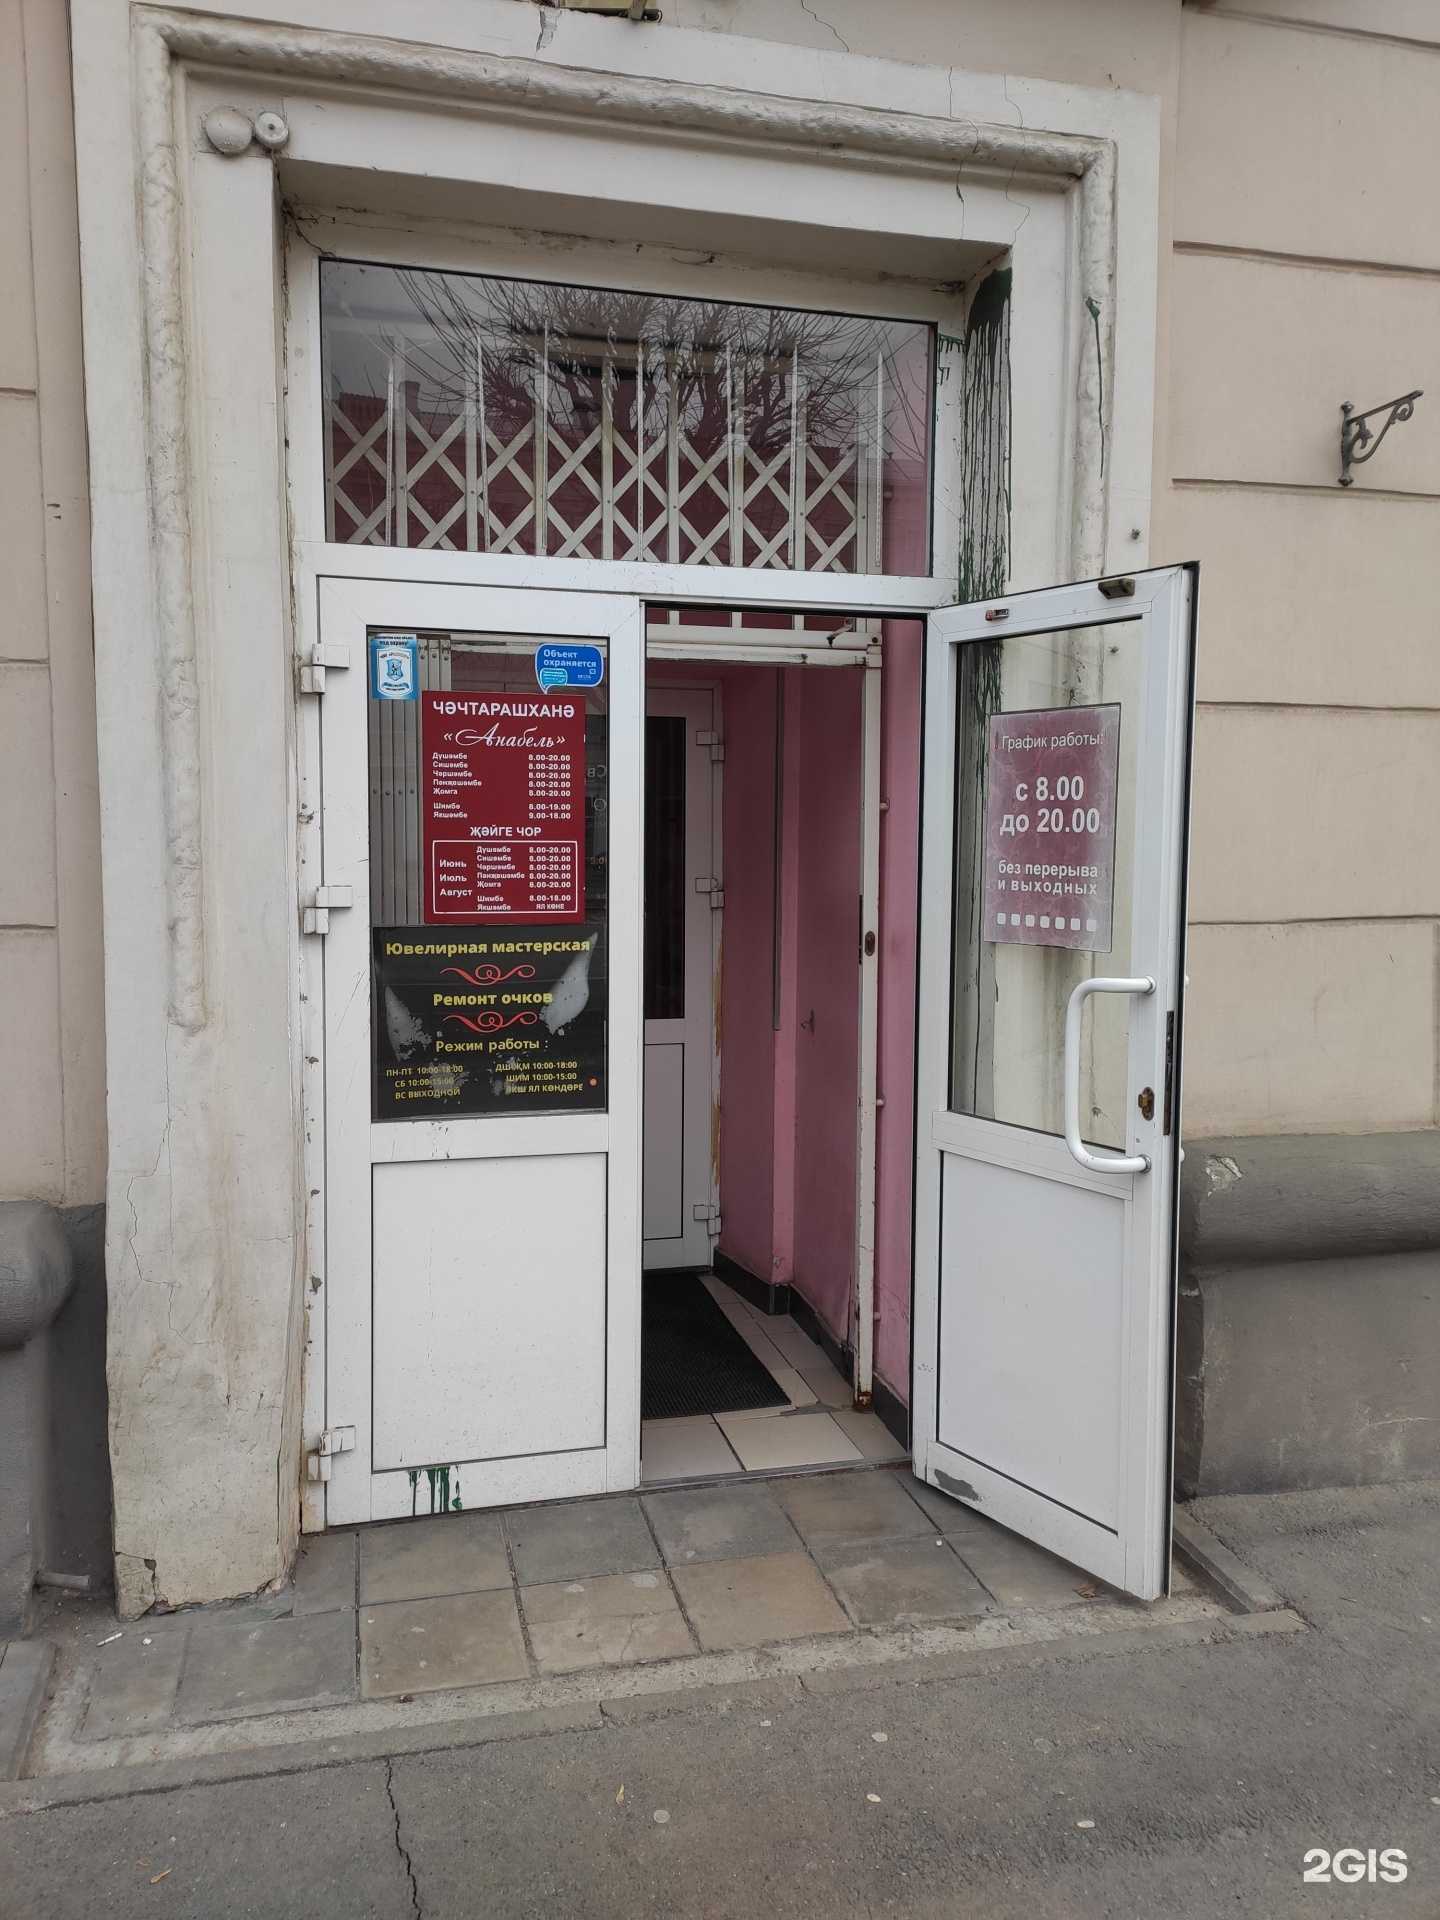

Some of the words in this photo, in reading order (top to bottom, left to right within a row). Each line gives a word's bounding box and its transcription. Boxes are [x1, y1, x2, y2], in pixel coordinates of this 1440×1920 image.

[543, 649, 578, 659] Объект
[543, 659, 597, 668] охраняется
[432, 701, 575, 718] ЧӘЧТАРАШХАНӘ
[1001, 734, 1048, 752] График
[1051, 731, 1104, 750] работы:
[1015, 783, 1028, 801] с
[1035, 775, 1085, 801] 8.00
[999, 813, 1030, 836] до
[1036, 807, 1100, 833] 20.00
[470, 824, 513, 838] ҖӘЙГЕ
[516, 826, 542, 837] ЧОР
[439, 859, 467, 868] Июнь
[998, 859, 1022, 874] без
[1025, 862, 1098, 879] перерыва
[439, 874, 468, 882] Июль
[439, 888, 473, 898] Август
[998, 879, 1006, 890] и
[1010, 880, 1097, 896] выходных
[386, 942, 488, 957] Ювелирная
[492, 940, 590, 955] мастерская
[433, 992, 497, 1006] Ремонт
[501, 991, 553, 1005] очков
[436, 1040, 483, 1052] Режим
[489, 1038, 540, 1053] работы
[532, 1061, 578, 1070] 10:00-18:00
[386, 1068, 412, 1078] ПН-ПТ
[506, 1073, 530, 1082] ШИМ
[532, 1072, 577, 1081] 10:00-15:00
[394, 1080, 406, 1088] СБ
[528, 1084, 540, 1093] ЯЛ
[395, 1091, 407, 1100] ВС
[408, 1087, 461, 1099] ВЫХОДНОЙ
